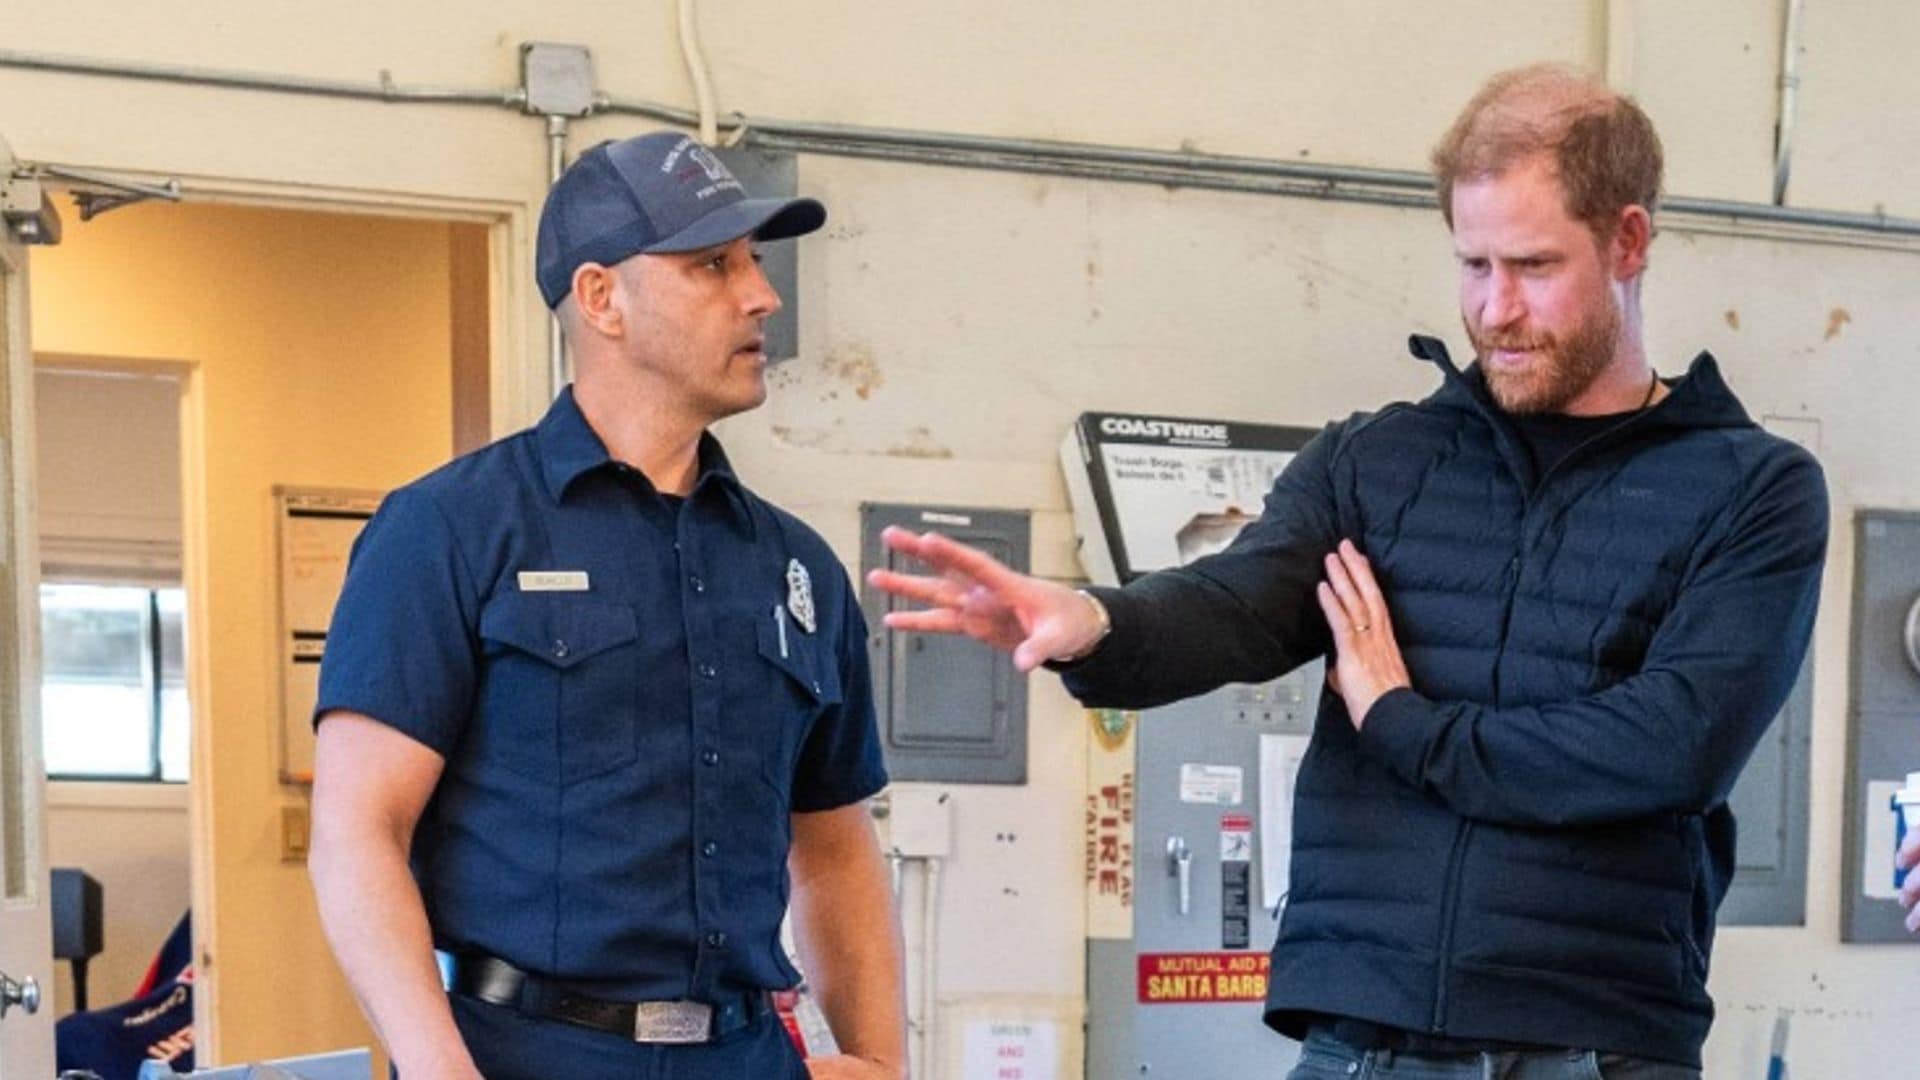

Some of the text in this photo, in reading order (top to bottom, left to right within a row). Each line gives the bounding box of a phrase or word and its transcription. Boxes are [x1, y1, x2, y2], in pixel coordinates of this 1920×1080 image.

[1100, 417, 1228, 440] COASTWIDE
[1100, 784, 1119, 895] FIRE
[1158, 957, 1223, 971] MUTUAL
[1228, 957, 1257, 971] AID
[1147, 975, 1267, 999] SANTA BARB
